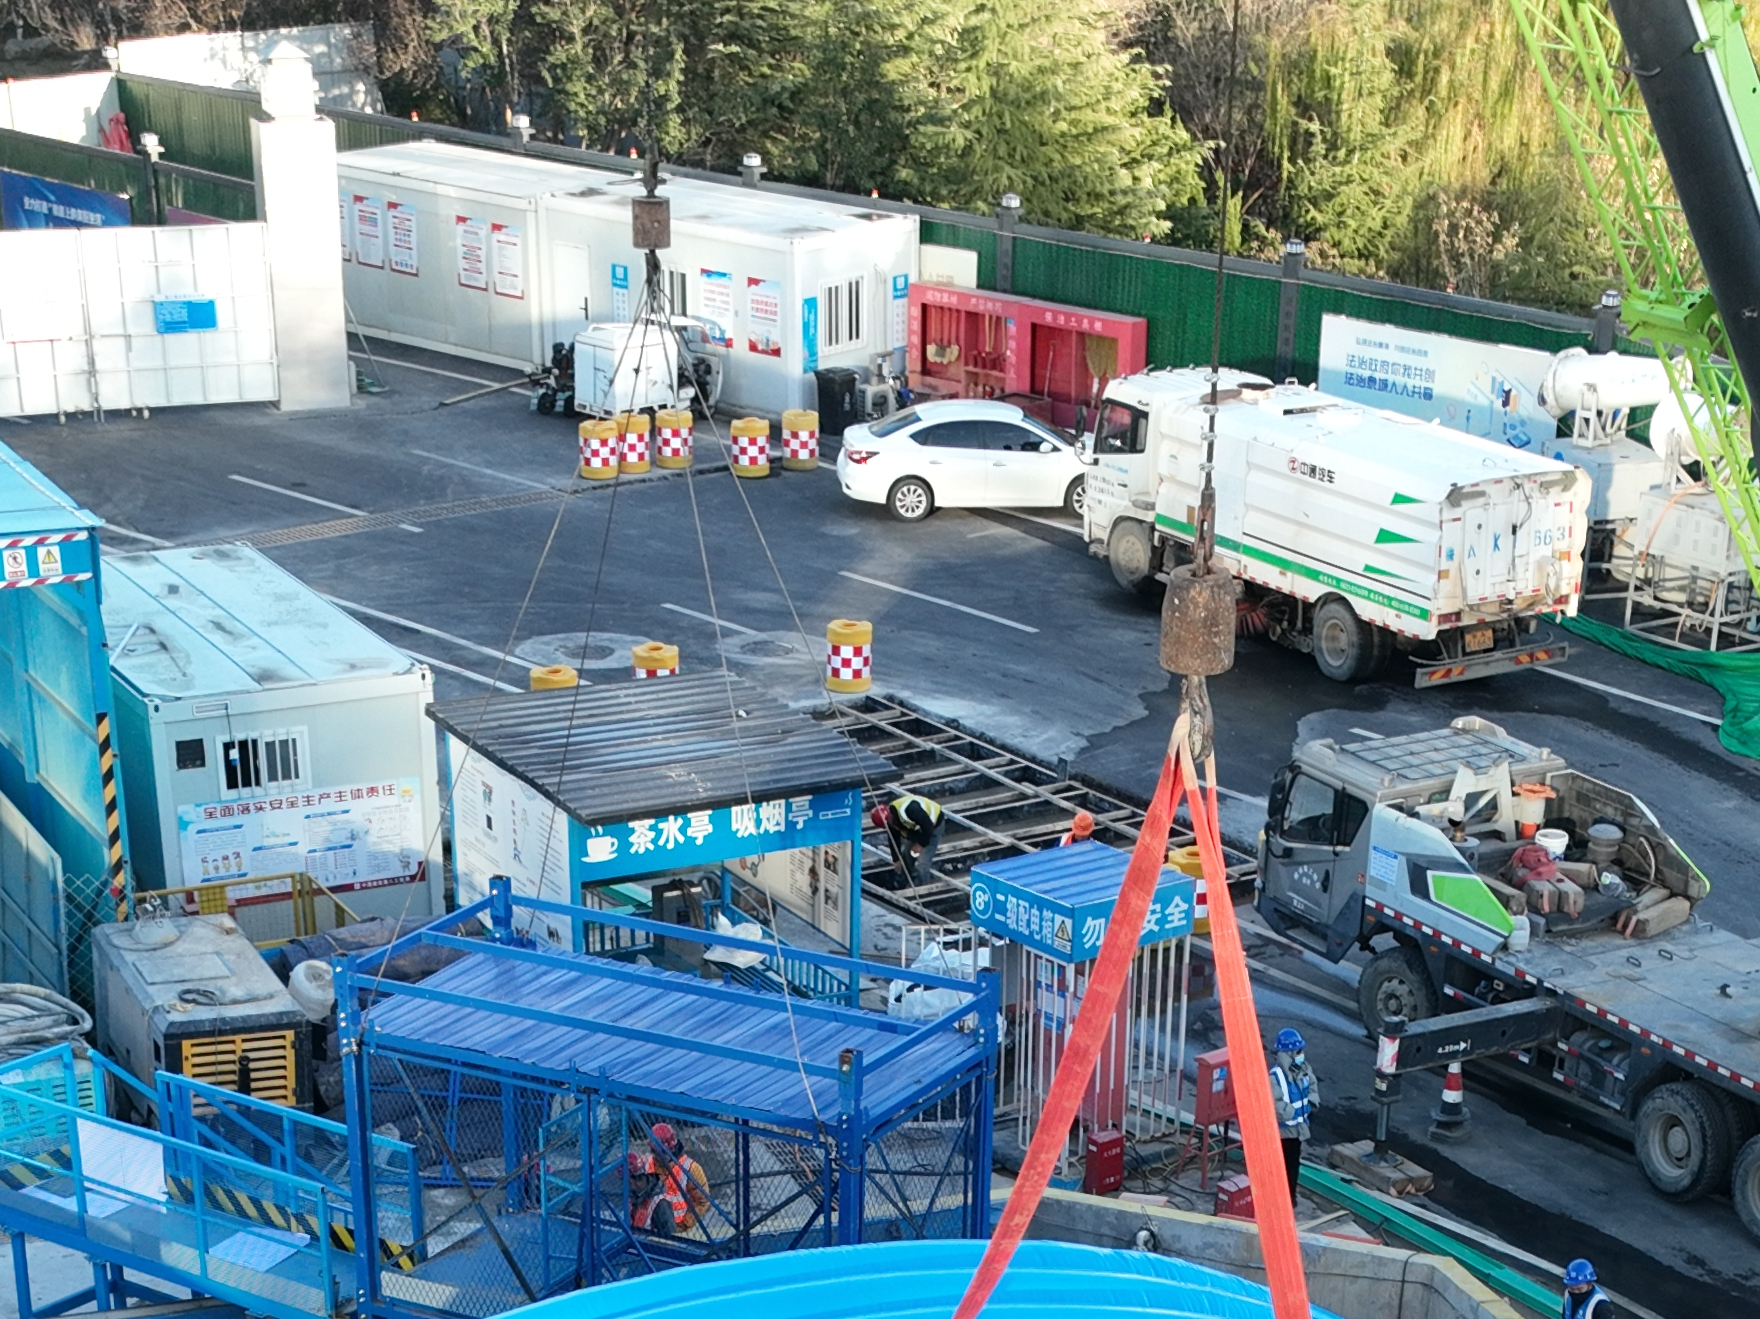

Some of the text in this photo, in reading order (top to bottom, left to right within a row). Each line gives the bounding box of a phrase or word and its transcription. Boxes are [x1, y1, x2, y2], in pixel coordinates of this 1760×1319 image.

[1298, 460, 1336, 484] 中通汽车
[203, 783, 396, 820] 全面落实安全生产主体责任
[627, 795, 814, 855] 茶水亭 吸烟亭
[994, 892, 1055, 946] 二级配电箱
